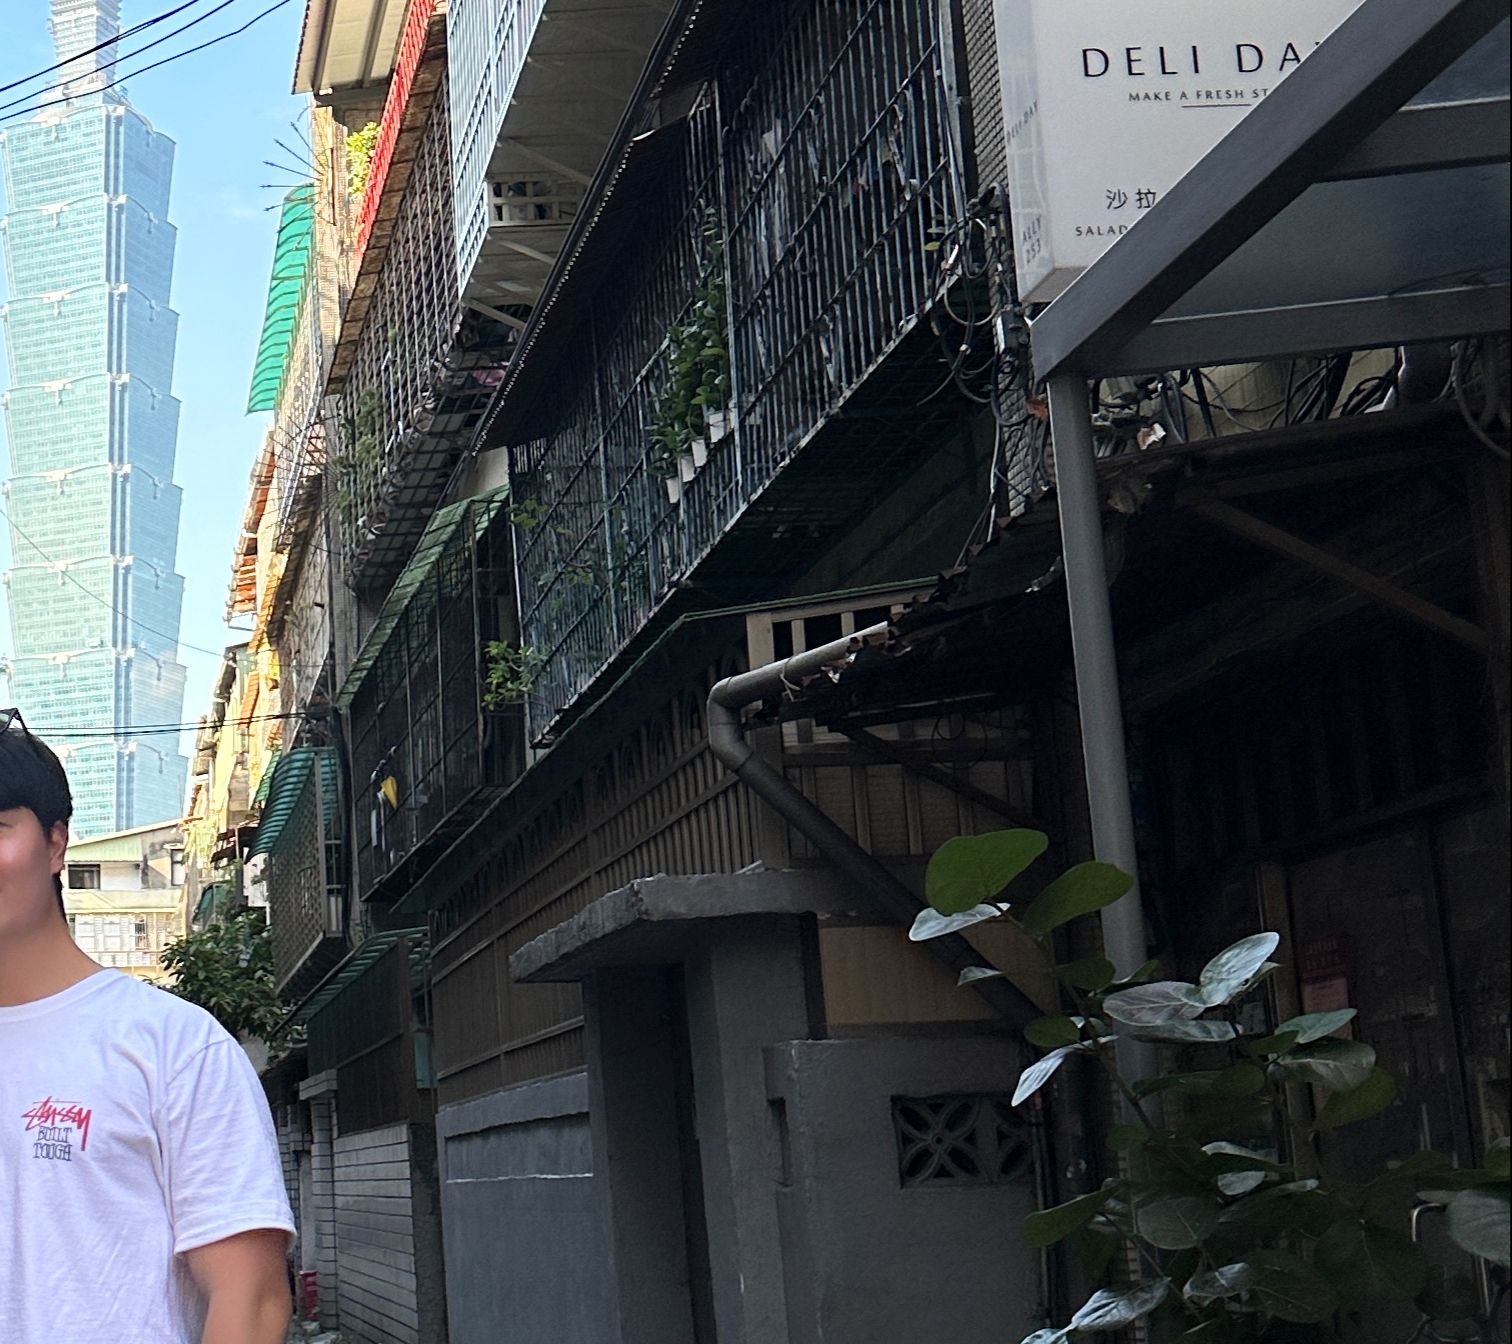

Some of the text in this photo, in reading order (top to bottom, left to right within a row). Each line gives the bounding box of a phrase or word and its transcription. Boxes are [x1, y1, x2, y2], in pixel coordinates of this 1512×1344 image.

[1082, 41, 1320, 77] DELI DA
[1129, 88, 1269, 102] MAKE A FRESH ST
[36, 1125, 73, 1144] BUILT
[33, 1142, 73, 1162] TOUGH
